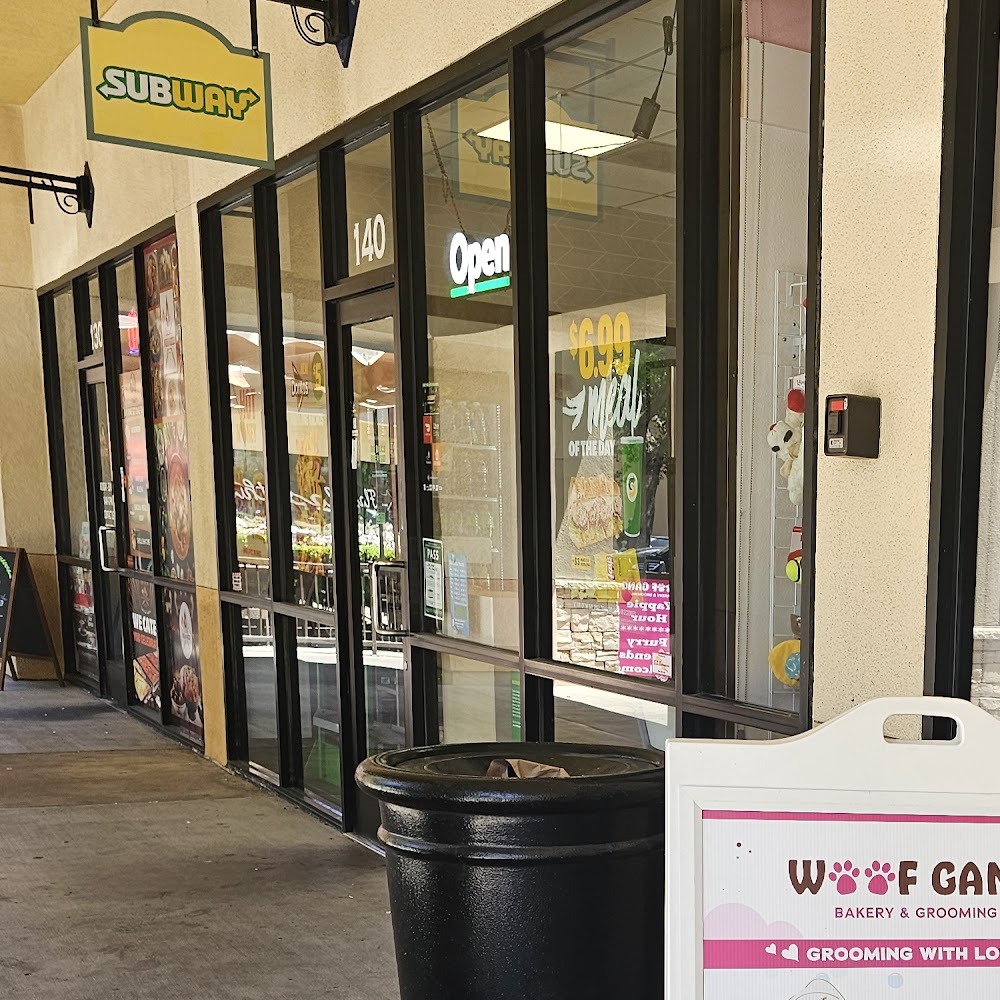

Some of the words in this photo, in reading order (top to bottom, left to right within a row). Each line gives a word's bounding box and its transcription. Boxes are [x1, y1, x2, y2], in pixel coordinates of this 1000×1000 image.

[96, 65, 261, 120] SUBWAY
[353, 213, 386, 266] 140
[450, 231, 510, 294] Open
[90, 321, 104, 351] 130
[569, 311, 631, 380] $6.99
[587, 349, 643, 441] meal
[568, 440, 579, 457] OF
[580, 440, 597, 457] THE
[598, 440, 615, 457] DAY
[426, 548, 439, 560] PASS
[132, 612, 143, 631] WE
[834, 907, 895, 919] BAKERY
[899, 907, 910, 919] &
[915, 907, 998, 919] GROOMING
[806, 946, 913, 962] GROOMING
[919, 946, 969, 961] WITH
